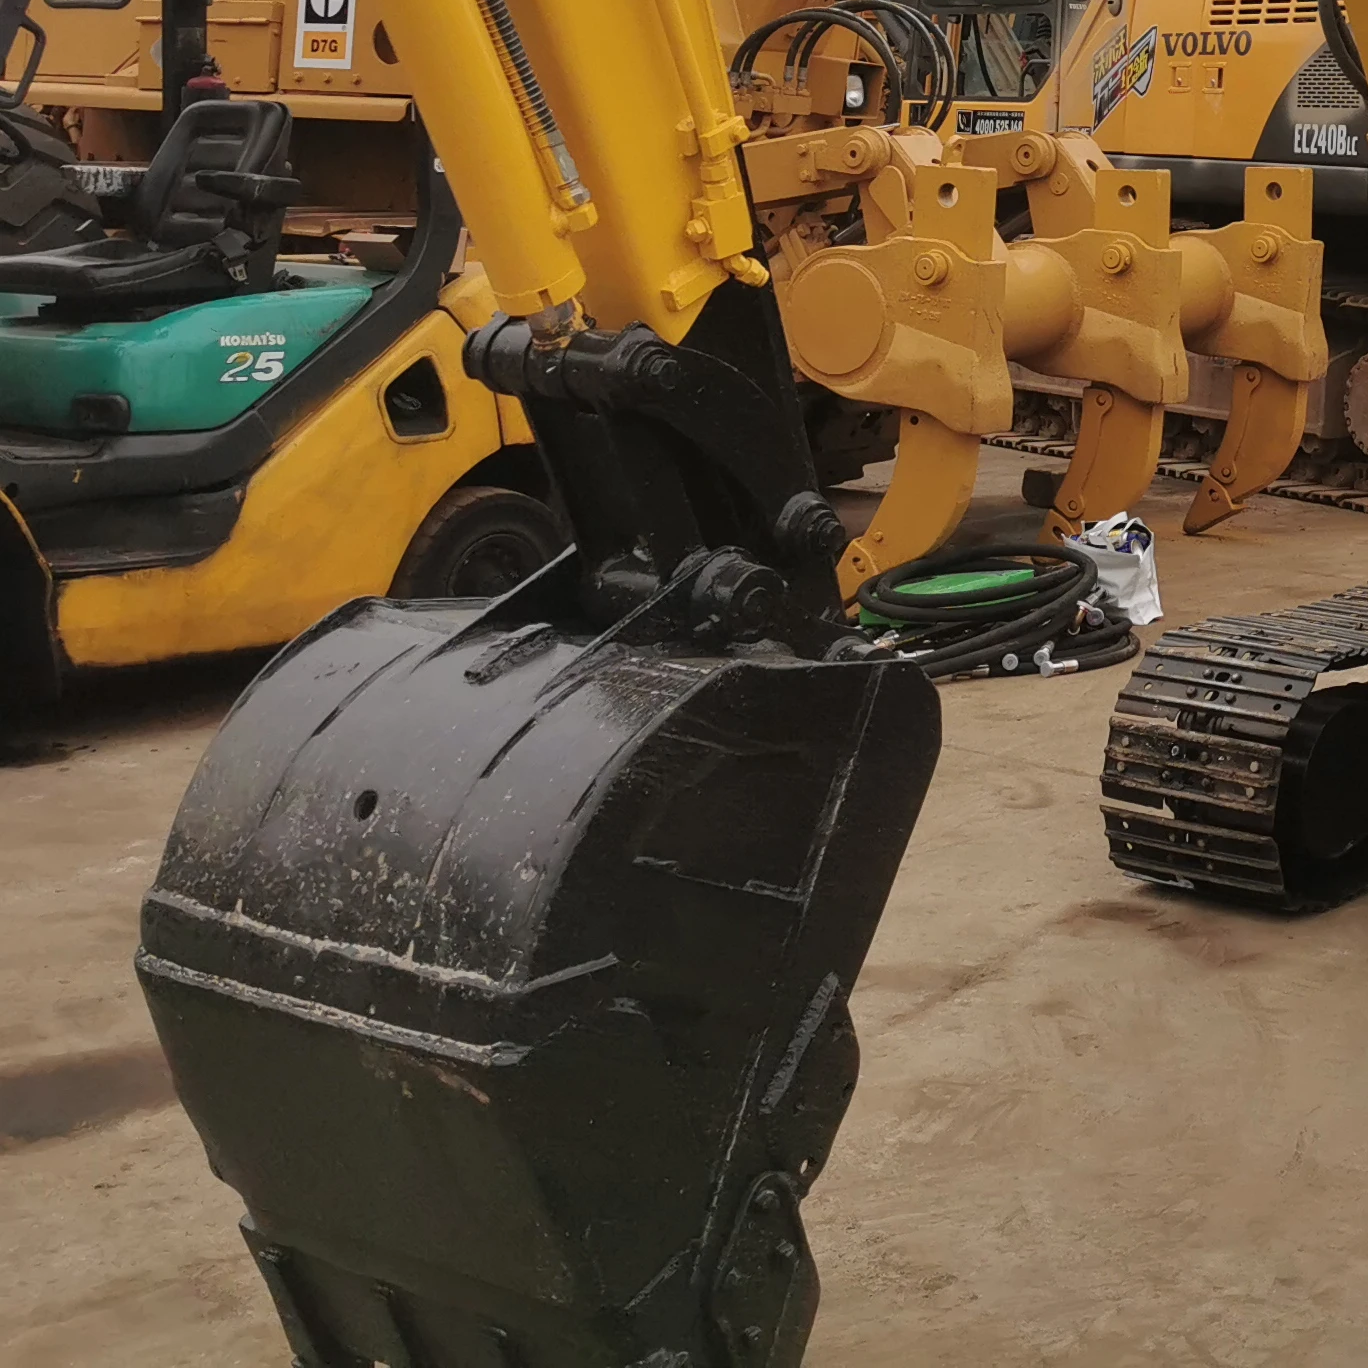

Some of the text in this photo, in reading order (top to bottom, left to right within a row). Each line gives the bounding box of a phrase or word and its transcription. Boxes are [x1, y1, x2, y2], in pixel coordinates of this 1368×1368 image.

[311, 38, 338, 53] D7G
[1162, 30, 1253, 57] VOLVO
[220, 331, 287, 347] KOMATSU
[219, 351, 285, 382] 25
